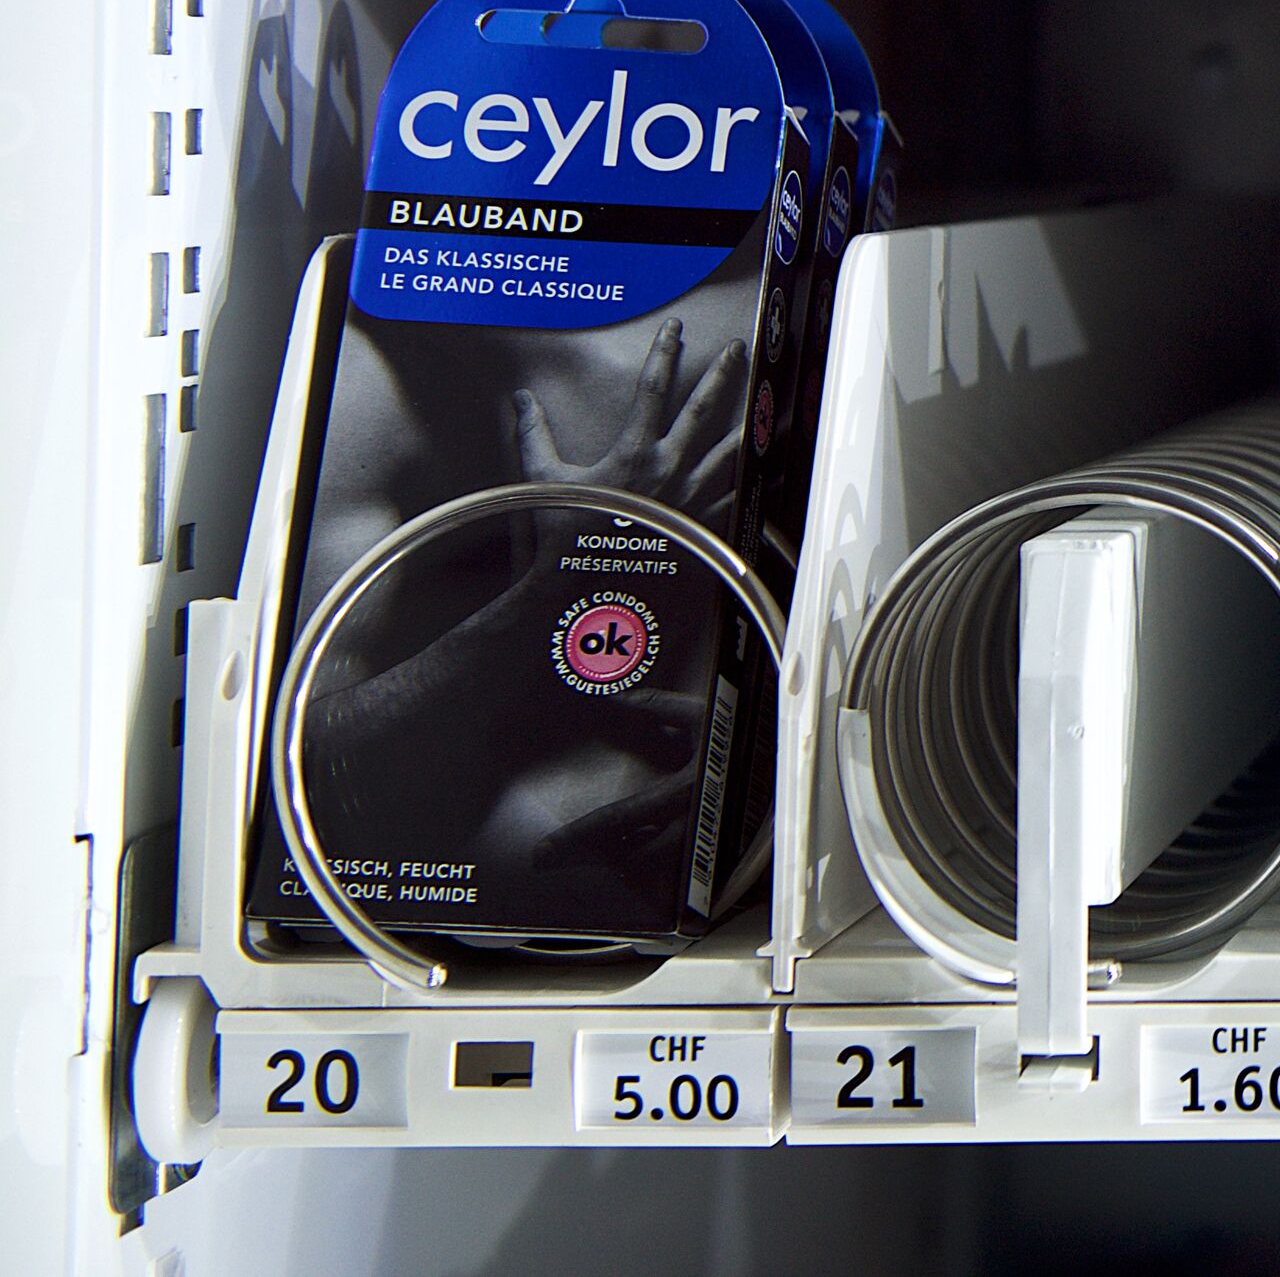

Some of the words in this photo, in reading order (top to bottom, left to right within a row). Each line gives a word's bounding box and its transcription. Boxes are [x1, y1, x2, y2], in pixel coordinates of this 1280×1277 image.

[398, 70, 760, 186] ceylor
[390, 200, 584, 234] BLAUBAND
[384, 246, 430, 266] DAS
[436, 250, 570, 273] KLASSISCHE
[380, 273, 406, 290] LE
[412, 274, 496, 296] GRAND
[501, 279, 625, 302] CLASSIQUE
[576, 535, 669, 553] KONDOME
[560, 555, 678, 575] PRÉSERVATIFS
[557, 597, 590, 628] SAFE
[592, 590, 660, 632] CONDOMS
[579, 622, 633, 656] ok
[551, 630, 661, 696] WWW.GUETESIEGEL.CH
[283, 857, 393, 879] KSISCH,
[400, 862, 476, 879] FEUCHT
[280, 880, 394, 902] CLQUE,
[400, 886, 479, 903] HUMIDE
[650, 1035, 706, 1063] CHF
[1212, 1027, 1267, 1054] CHF
[266, 1048, 360, 1115] 20
[836, 1045, 924, 1109] 21
[614, 1074, 739, 1121] 5.00
